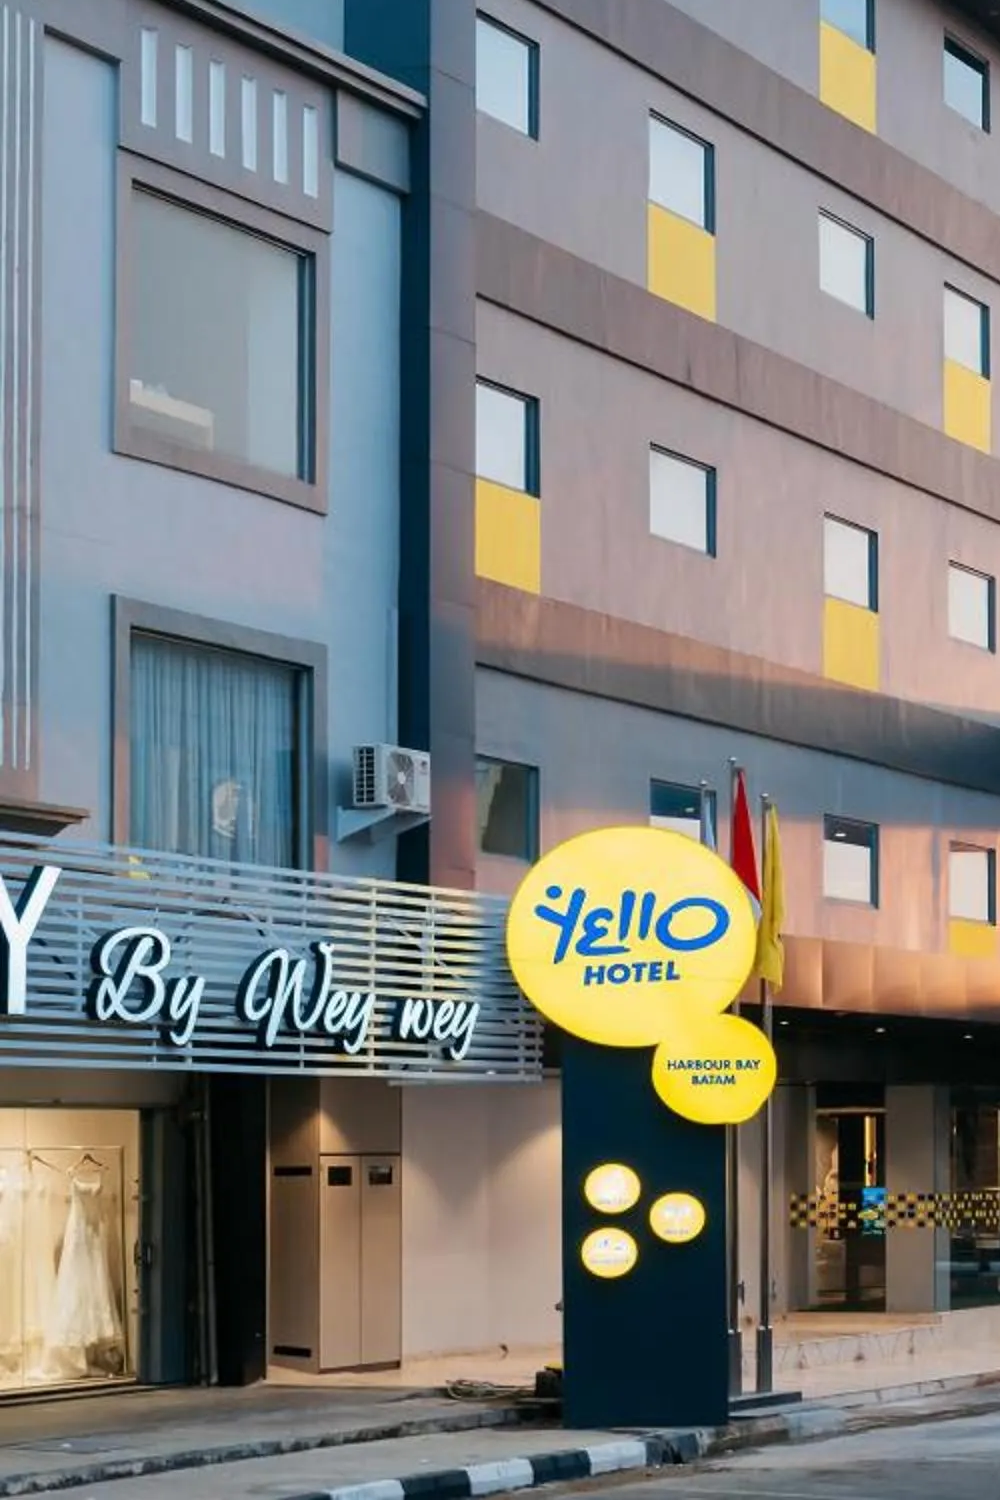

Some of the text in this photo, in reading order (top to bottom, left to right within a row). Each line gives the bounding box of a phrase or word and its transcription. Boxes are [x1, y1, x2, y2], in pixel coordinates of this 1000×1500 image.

[582, 960, 681, 987] HOTEL
[92, 925, 206, 1047] By
[242, 941, 377, 1055] Wey
[667, 1059, 761, 1071] HARBOUR BAY
[691, 1074, 736, 1085] BATAM
